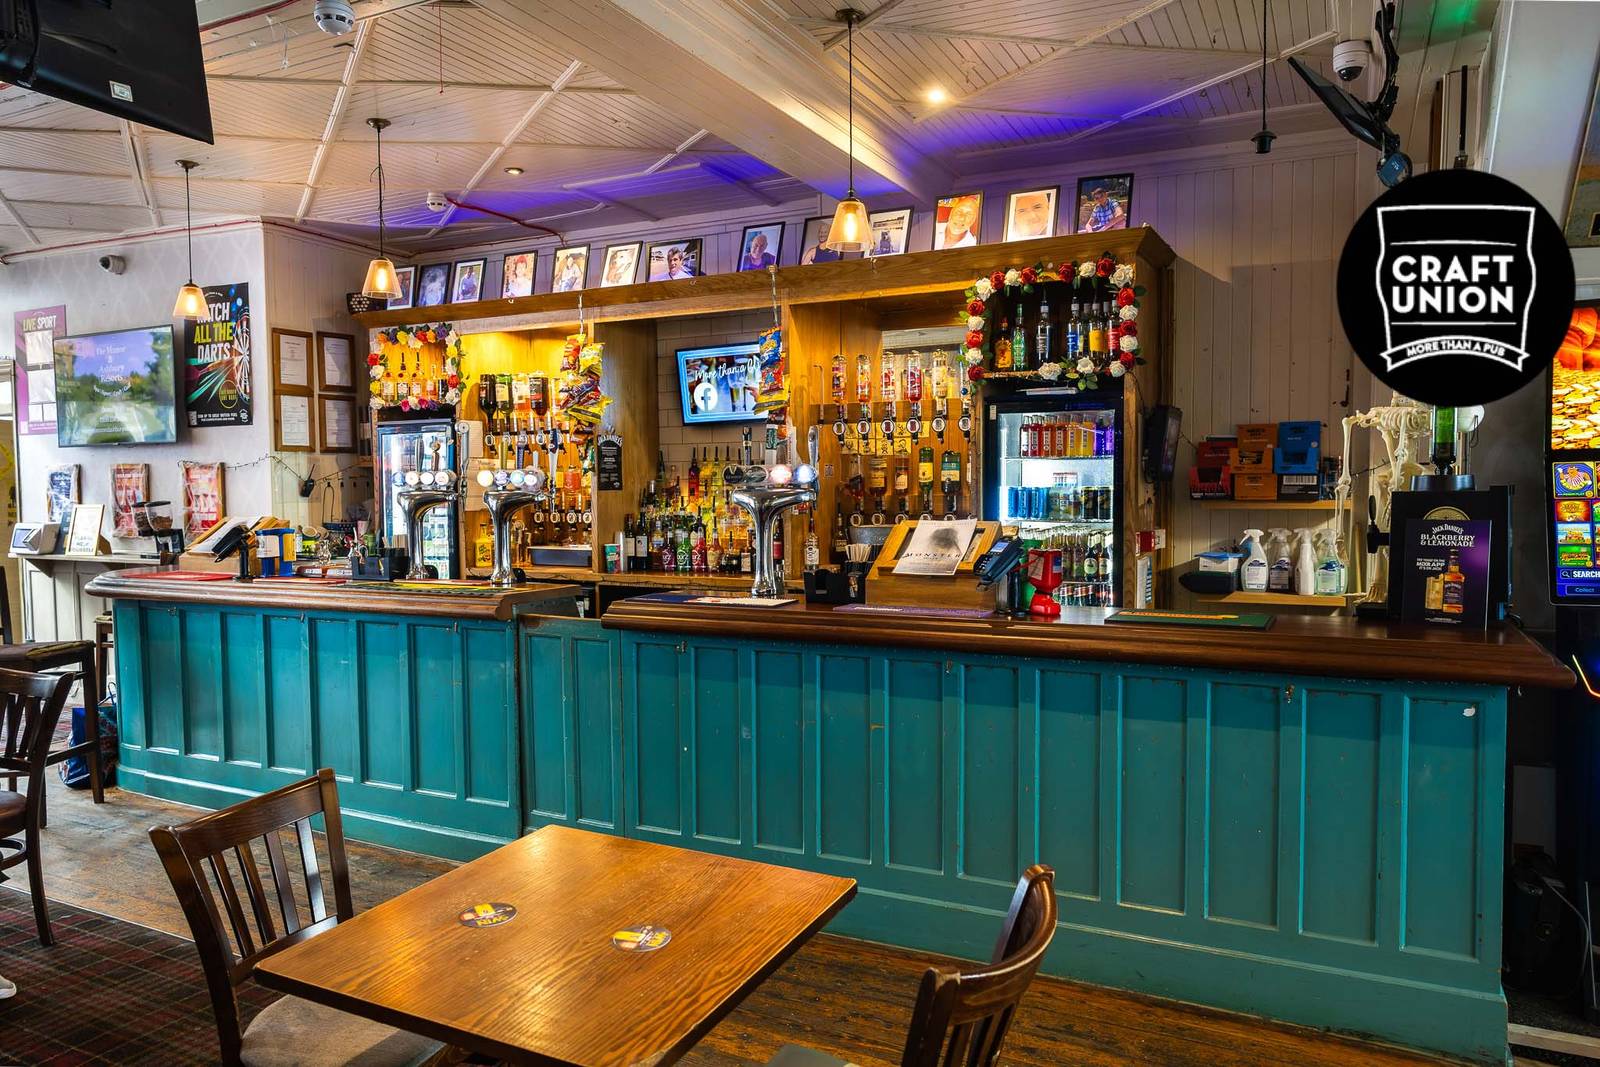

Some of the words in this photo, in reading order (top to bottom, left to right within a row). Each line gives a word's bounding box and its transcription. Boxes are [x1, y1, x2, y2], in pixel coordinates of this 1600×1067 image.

[22, 318, 37, 331] LIVE
[37, 315, 57, 329] SPORT
[194, 325, 212, 344] ALL
[212, 322, 233, 342] THE
[197, 342, 231, 364] DARTS
[695, 370, 717, 380] More
[718, 362, 738, 378] than
[1420, 533, 1476, 542] BLACKBERRY
[1573, 570, 1600, 578] SEARCH
